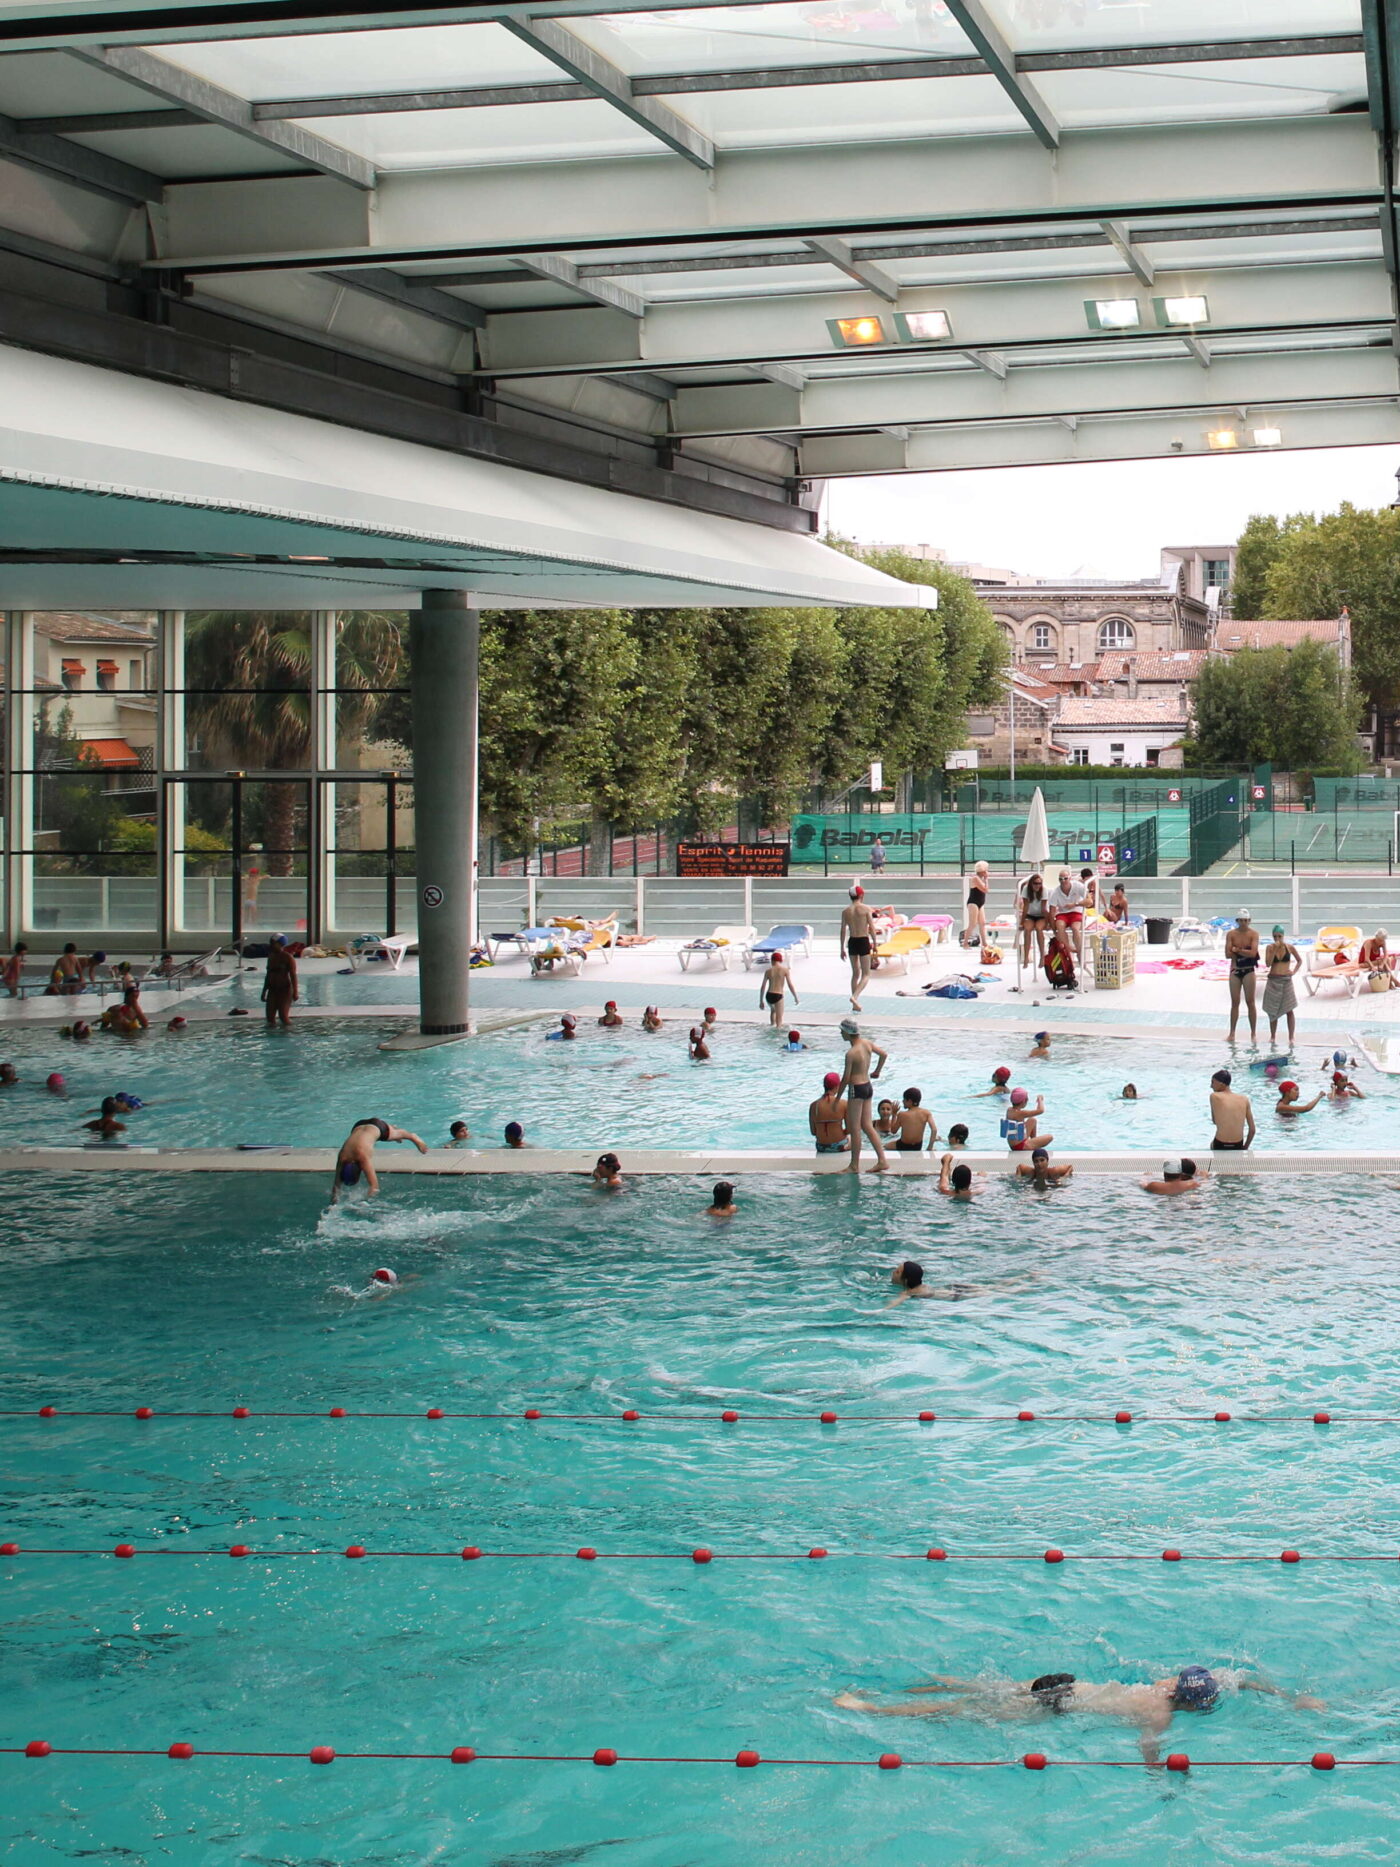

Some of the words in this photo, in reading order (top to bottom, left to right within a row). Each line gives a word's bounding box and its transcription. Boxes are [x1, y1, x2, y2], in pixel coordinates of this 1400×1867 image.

[678, 844, 723, 856] Esprit
[739, 844, 784, 856] Tennis
[1125, 850, 1132, 859] 2
